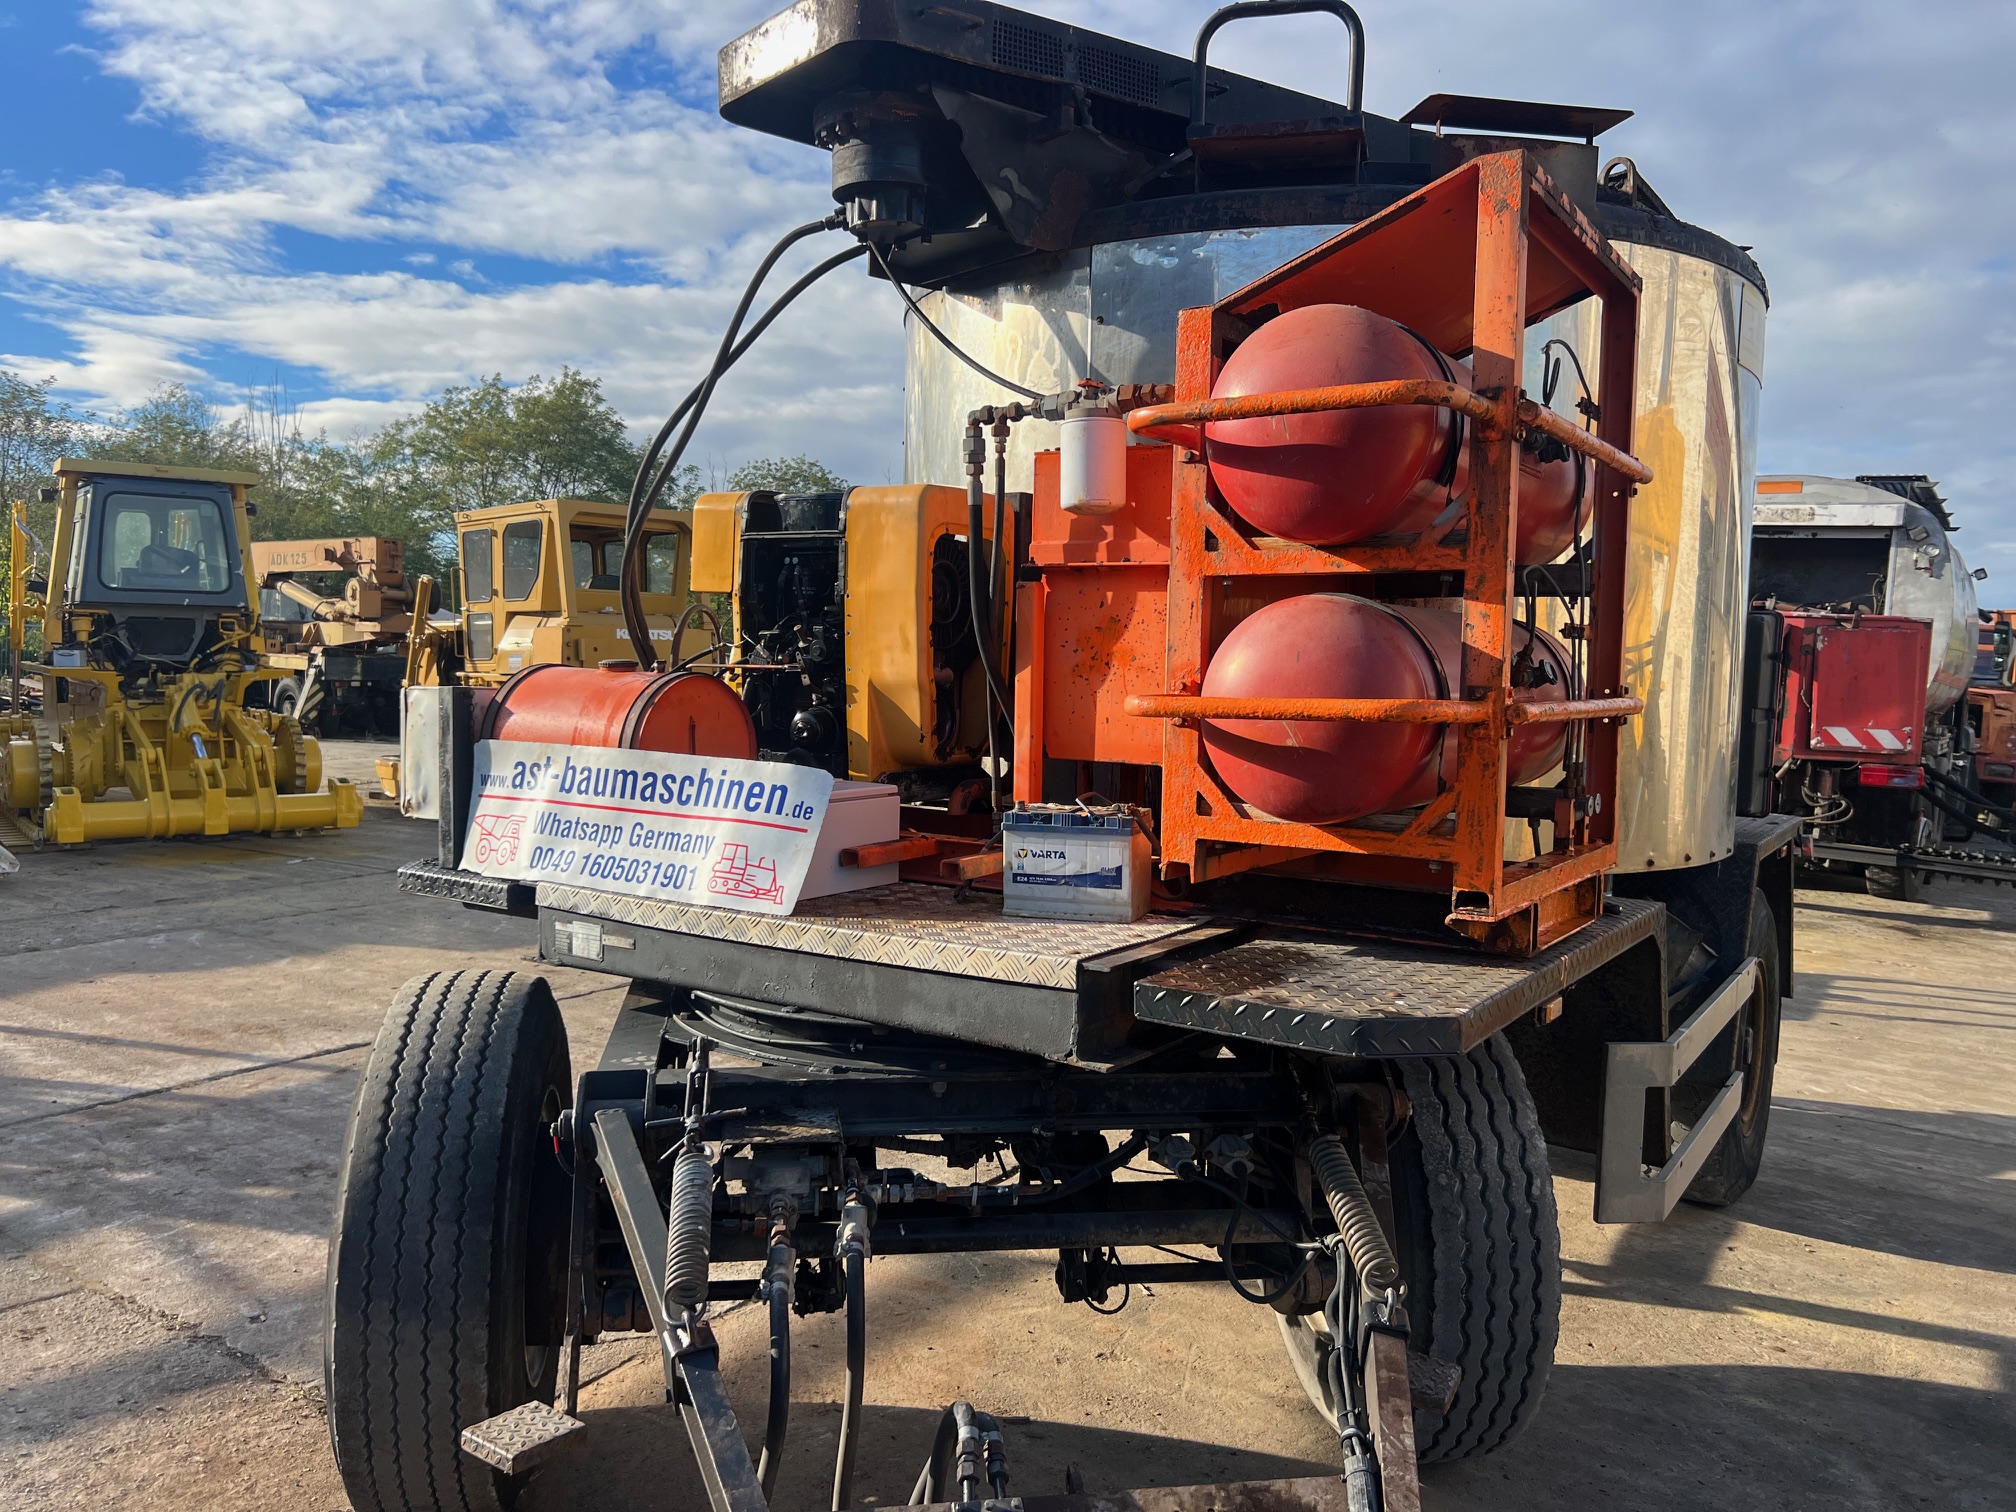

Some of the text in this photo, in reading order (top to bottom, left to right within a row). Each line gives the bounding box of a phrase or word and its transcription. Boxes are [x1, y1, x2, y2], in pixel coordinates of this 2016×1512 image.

[271, 553, 307, 566] ADK 125
[480, 756, 814, 821] www.ast-baumaschinen.de
[533, 811, 716, 860] Whatsapp Germany
[1030, 850, 1066, 860] VARTA
[529, 846, 698, 891] 0049 1605031901
